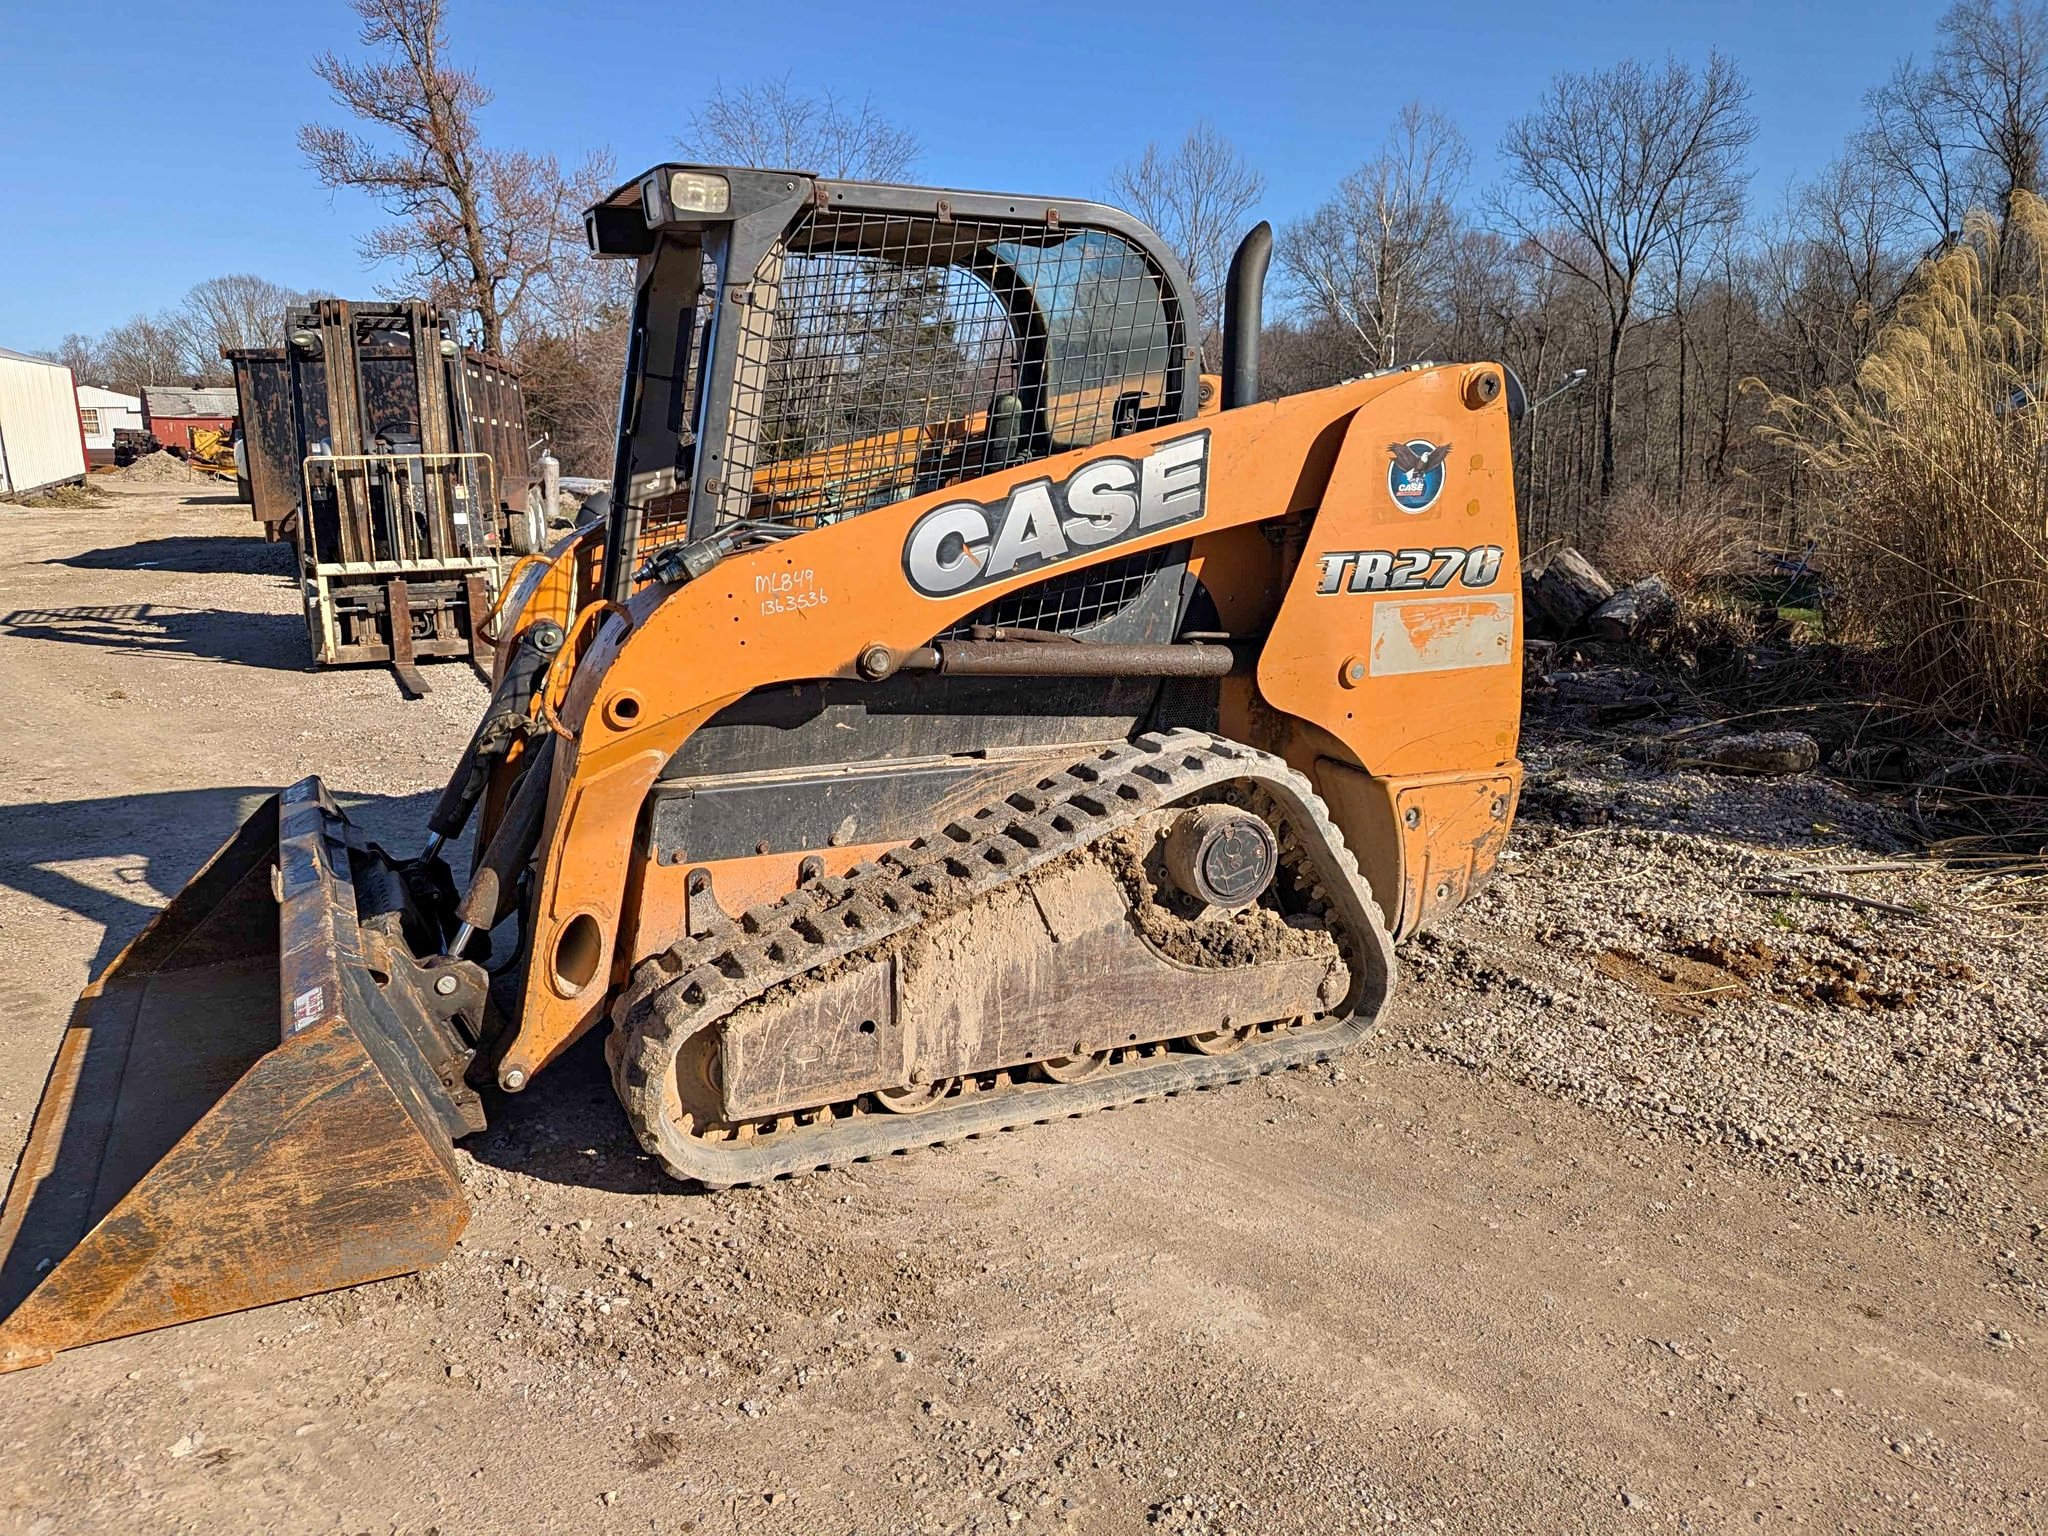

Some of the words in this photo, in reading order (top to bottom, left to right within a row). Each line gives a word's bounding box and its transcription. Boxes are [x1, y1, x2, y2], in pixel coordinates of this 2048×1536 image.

[1398, 483, 1424, 492] CASE
[905, 433, 1208, 595] CASE
[755, 569, 814, 594] ML849
[1315, 545, 1504, 595] TR270
[761, 587, 829, 616] 1363536
